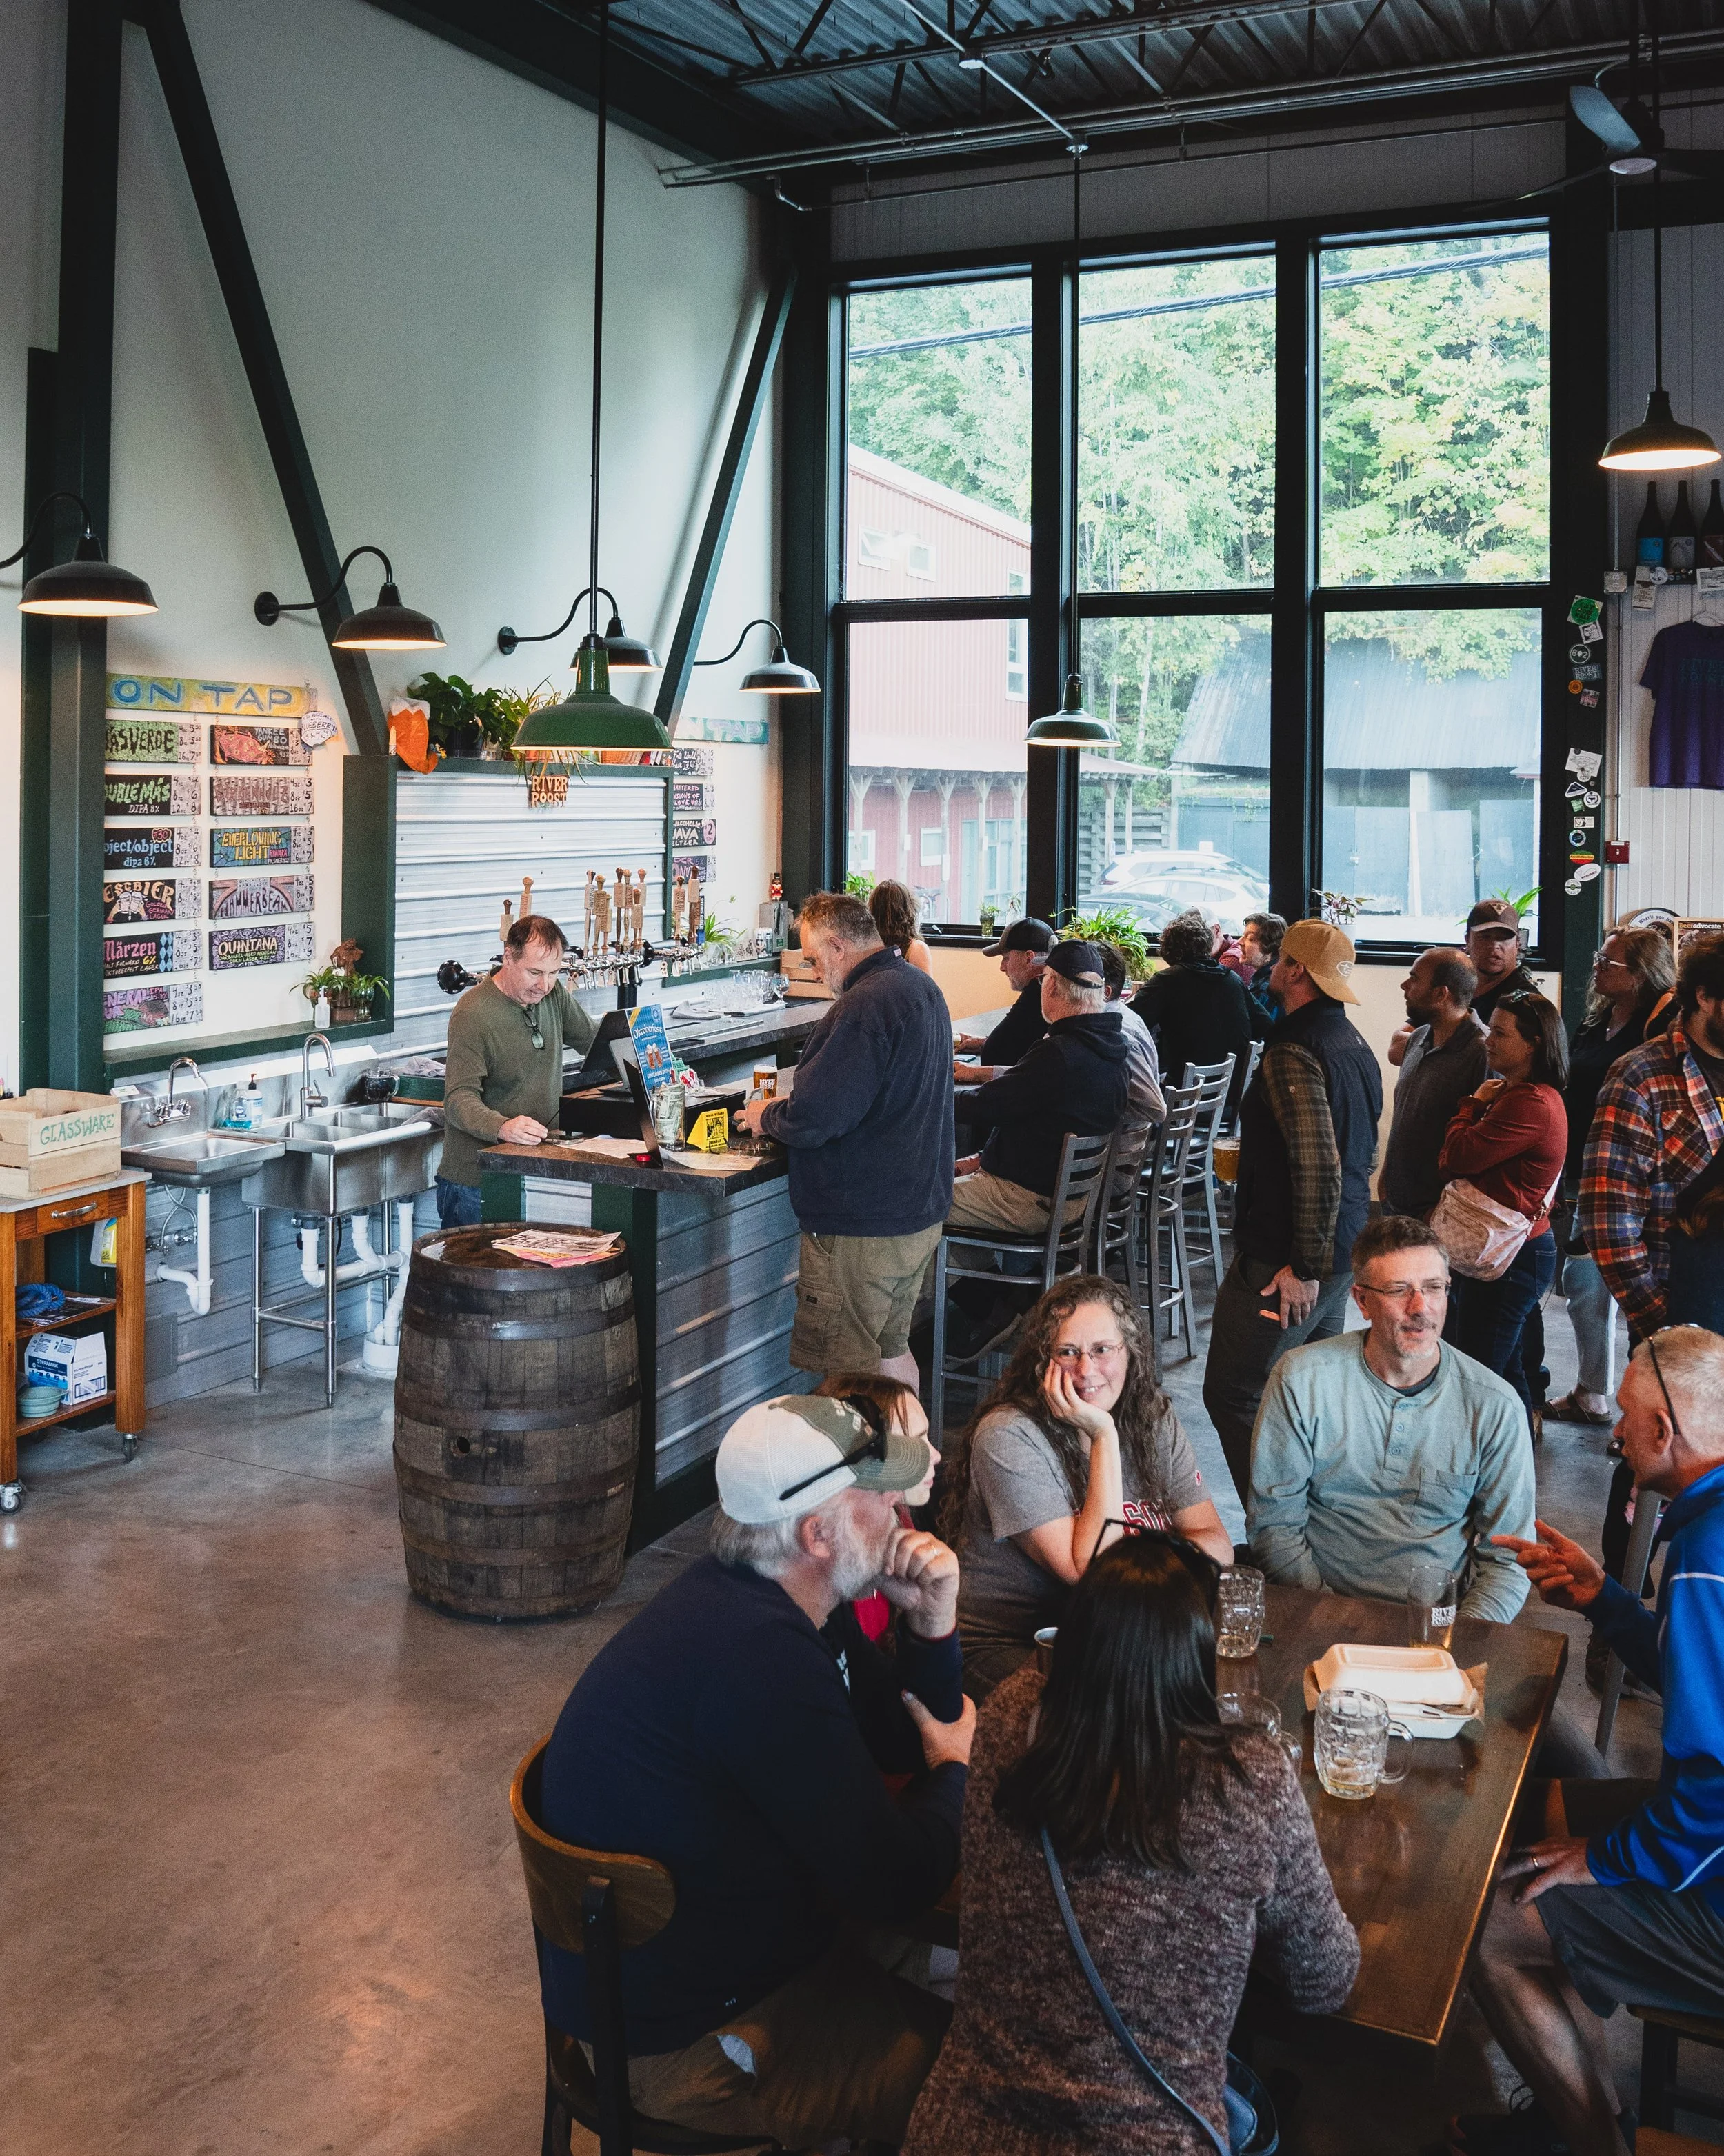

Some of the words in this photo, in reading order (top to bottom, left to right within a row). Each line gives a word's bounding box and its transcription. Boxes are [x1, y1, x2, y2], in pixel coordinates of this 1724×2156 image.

[1574, 666, 1598, 674] RIVER
[1576, 672, 1600, 680] ROOST
[114, 680, 181, 704] ON
[202, 685, 292, 711] TAP
[254, 728, 285, 736] YANKEE
[257, 735, 288, 744] GUMBO
[532, 776, 568, 792] RIVER
[531, 792, 568, 808] ROOST
[128, 805, 149, 814] DIPA
[290, 802, 303, 812] 16oz
[222, 831, 281, 846] EVERLOVING
[235, 846, 270, 860] LIGHT
[124, 857, 142, 867] dipa
[143, 857, 157, 866] 8%
[220, 887, 289, 918] HAMMERBEAM
[1638, 915, 1654, 924] What'll
[217, 937, 278, 956] QUINTANA
[143, 956, 156, 965] 6%
[40, 1113, 114, 1145] GLASSWARE
